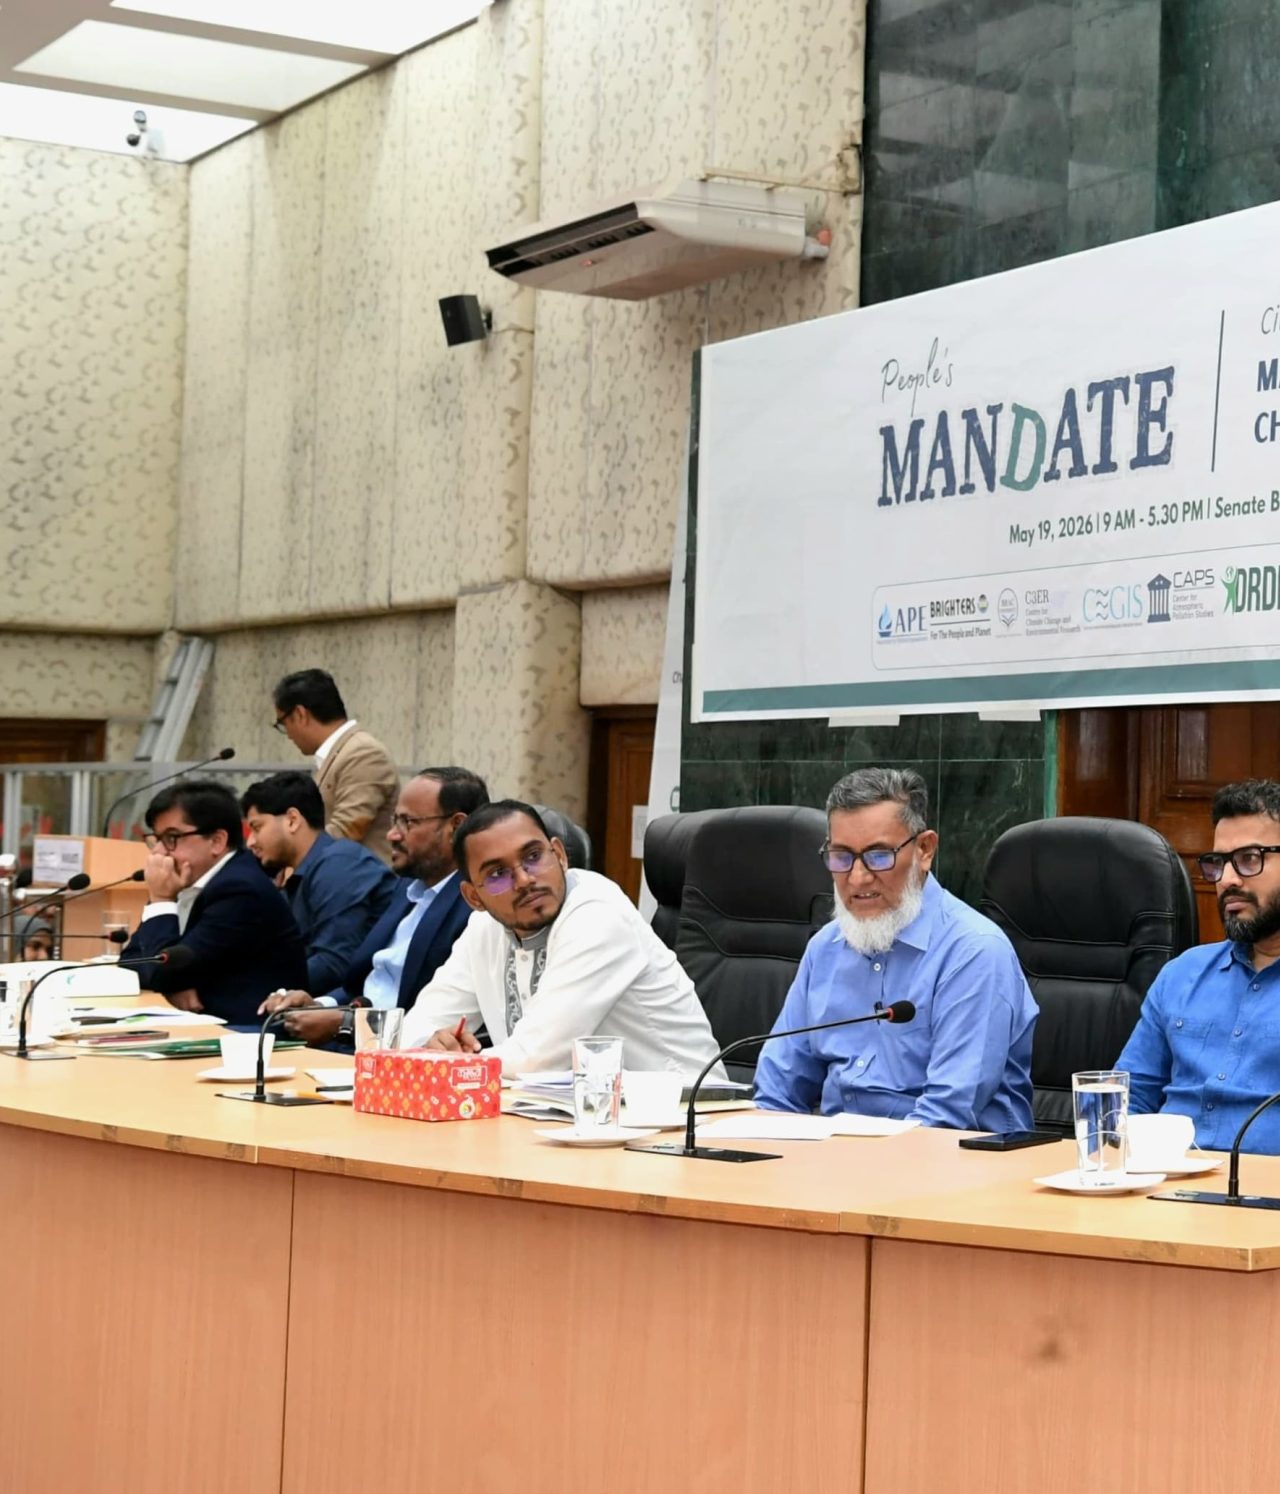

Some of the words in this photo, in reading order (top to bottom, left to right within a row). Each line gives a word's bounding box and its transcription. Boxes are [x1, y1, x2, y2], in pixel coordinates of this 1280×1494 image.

[881, 337, 954, 418] People's
[877, 365, 1176, 508] MANDATE
[1009, 524, 1035, 547] May
[1038, 519, 1055, 542] 19,
[1058, 513, 1093, 538] 2026
[1103, 511, 1112, 533] 9
[1114, 508, 1136, 531] AM
[1148, 501, 1179, 527] 5.30
[1182, 499, 1204, 522] PM
[1214, 495, 1266, 519] Senate
[1173, 568, 1215, 588] CAPS
[895, 605, 927, 633] APE
[930, 597, 976, 618] BRIGHTERS
